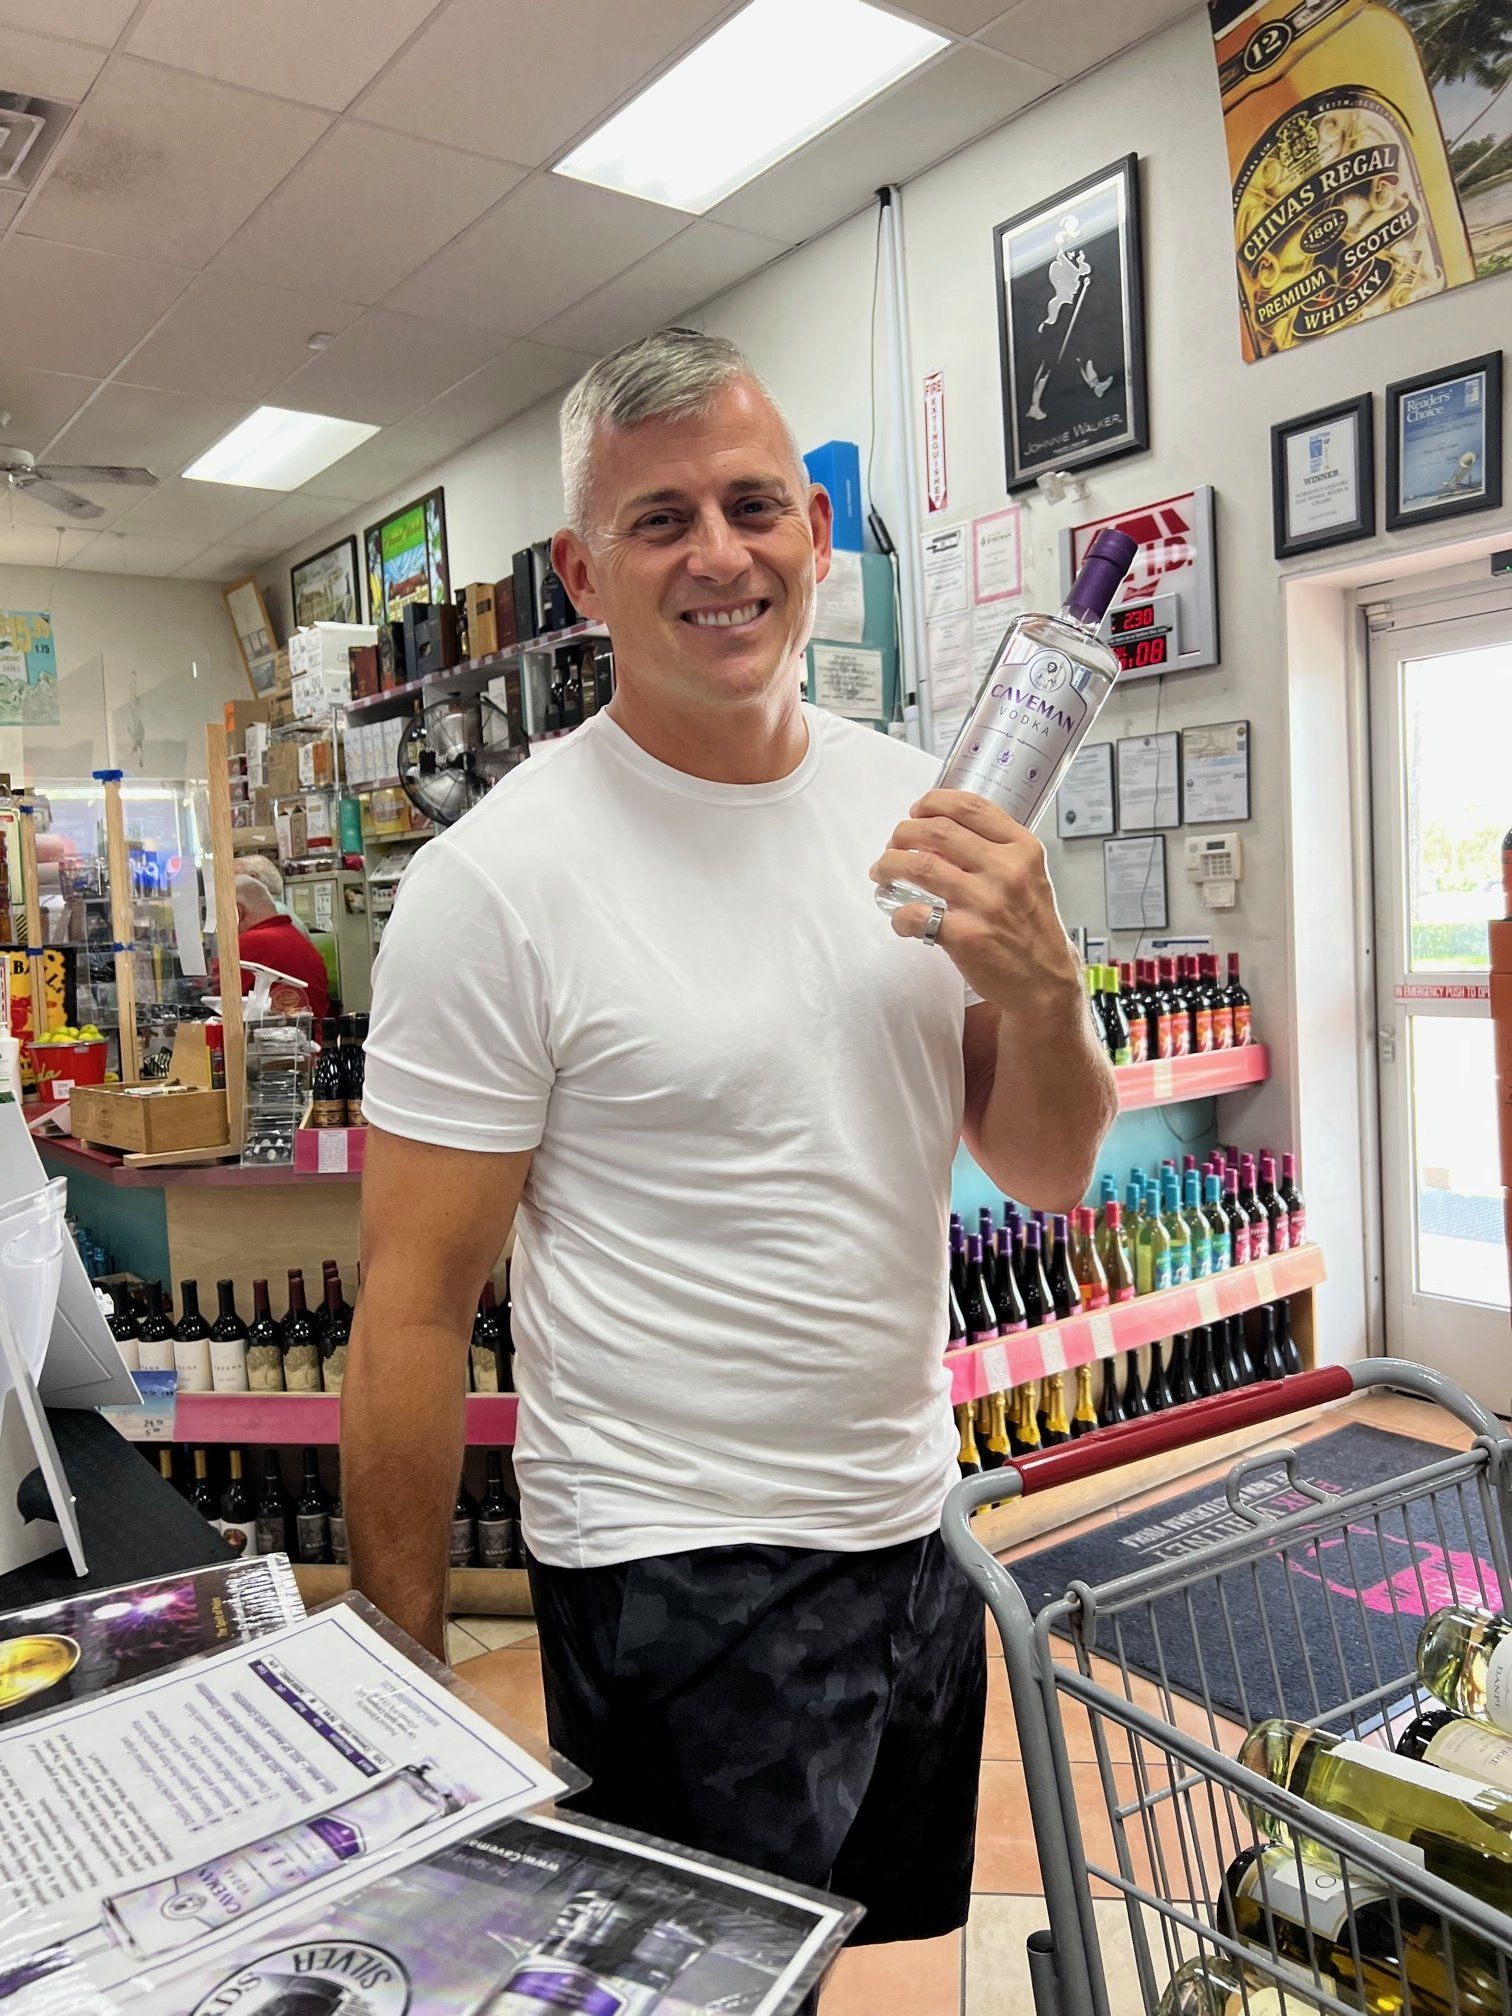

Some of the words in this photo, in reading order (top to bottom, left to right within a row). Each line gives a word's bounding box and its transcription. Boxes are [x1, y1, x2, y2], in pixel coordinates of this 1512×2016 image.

[1252, 29, 1283, 64] 12
[1243, 188, 1316, 262] CHIVAS
[1319, 147, 1396, 193] REGAL
[1307, 218, 1340, 244] 1801
[1257, 270, 1326, 322] PREMIUM
[1344, 210, 1413, 268] SCOTCH
[1304, 268, 1383, 332] WHISKY
[1406, 405, 1445, 423] Choice
[930, 396, 941, 501] EXTINGUISHER
[1023, 431, 1070, 456] JOHNNIE
[1303, 469, 1340, 486] WINNER
[35, 643, 50, 654] 1.75
[991, 684, 1076, 733] CAVEMAN
[1000, 705, 1051, 738] VODKA
[1404, 985, 1443, 998] EMERGENCY
[1445, 986, 1465, 998] PUSH
[1467, 986, 1477, 998] TO
[1268, 1479, 1343, 1511] PNK
[195, 1865, 243, 1916] CAVEMAN
[293, 1947, 392, 1990] SILVER
